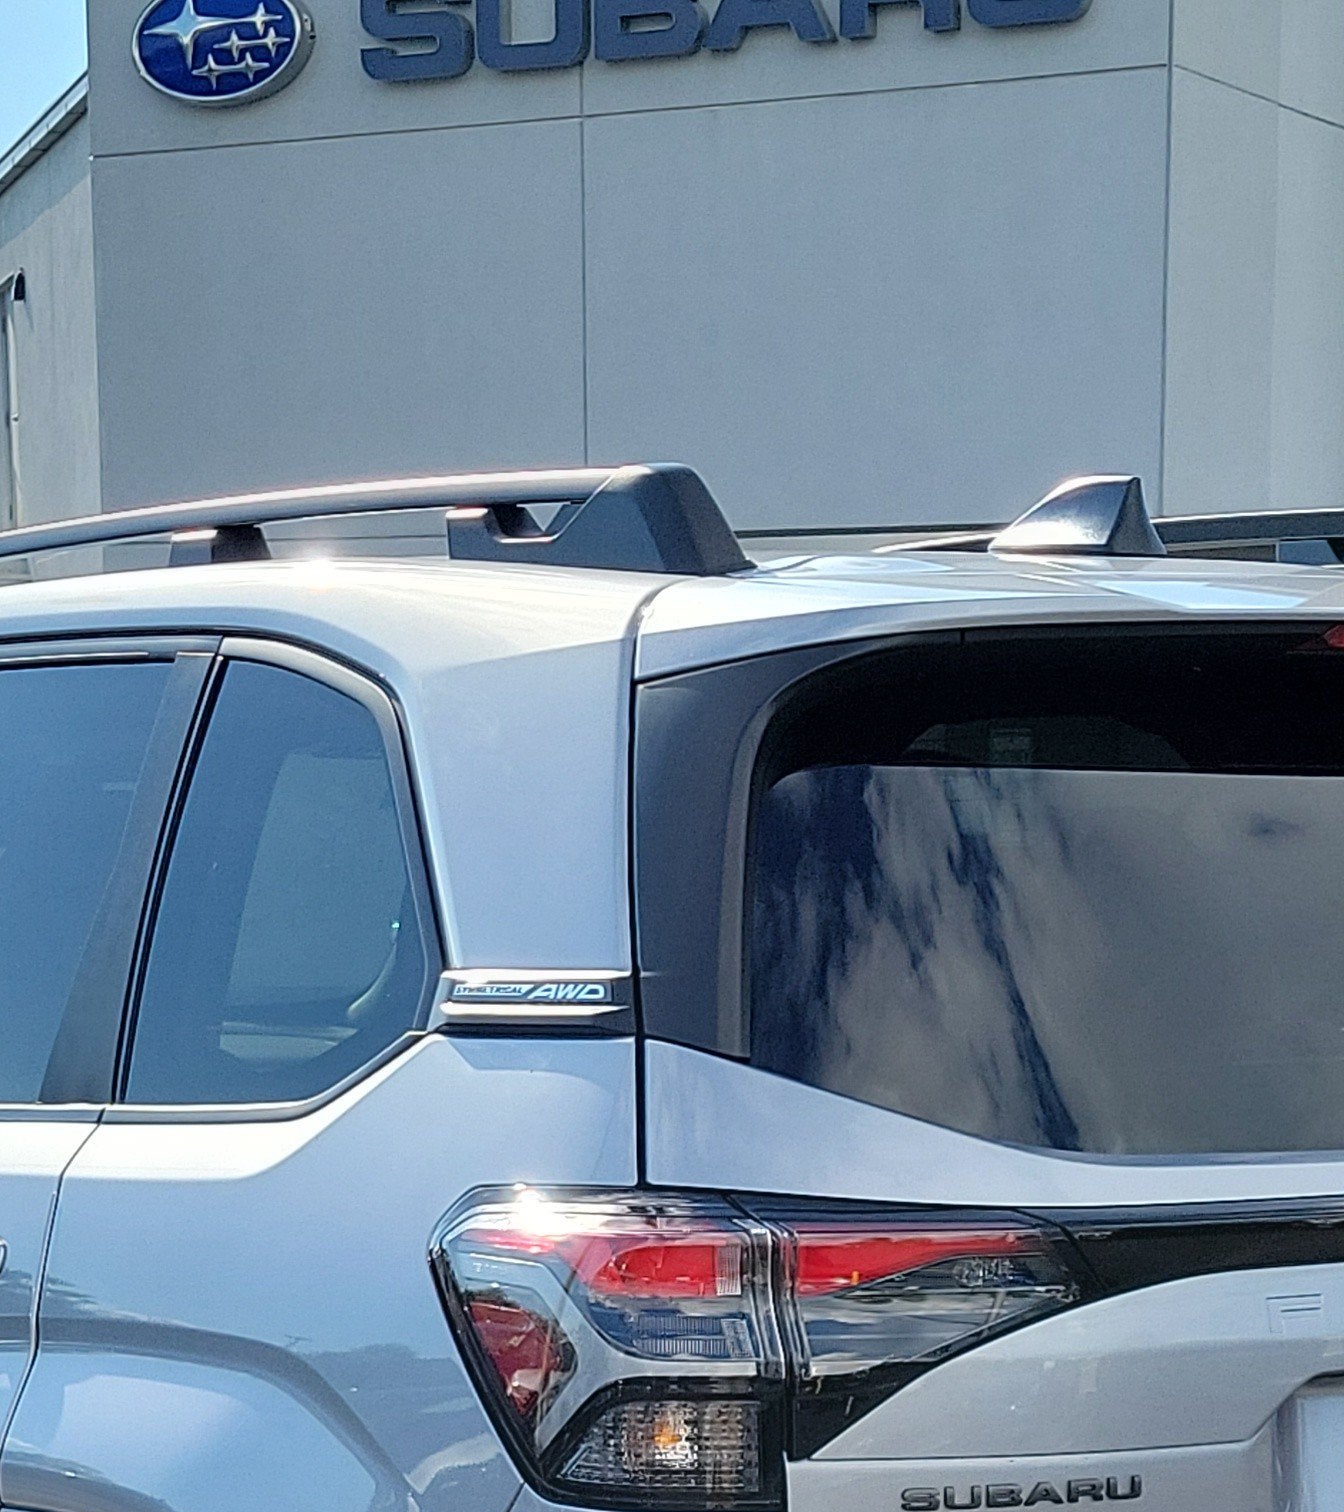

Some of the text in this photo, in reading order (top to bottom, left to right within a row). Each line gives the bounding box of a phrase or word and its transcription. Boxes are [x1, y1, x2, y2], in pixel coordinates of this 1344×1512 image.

[360, 0, 1091, 83] SUB
[527, 983, 605, 1000] AWD
[900, 1475, 1142, 1511] SUBARU
